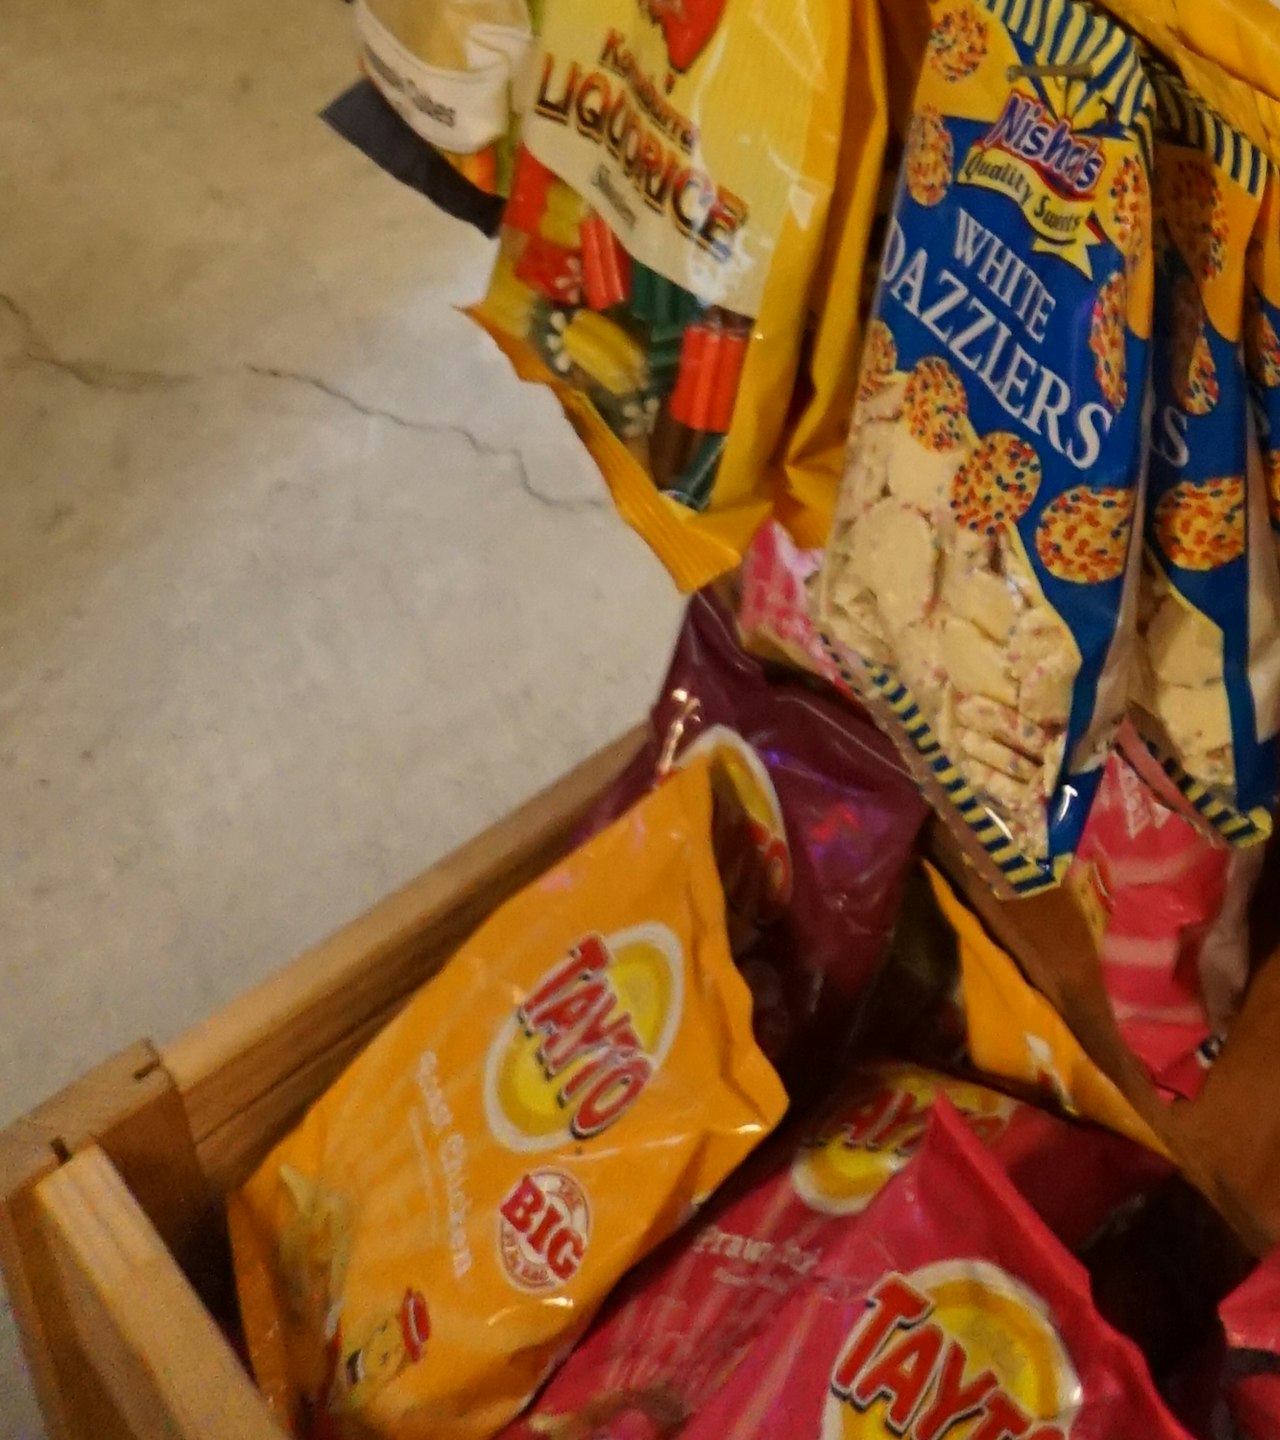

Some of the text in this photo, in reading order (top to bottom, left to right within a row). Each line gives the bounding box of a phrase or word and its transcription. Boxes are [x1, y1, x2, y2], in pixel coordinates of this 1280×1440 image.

[963, 154, 1034, 206] Quality
[988, 92, 1104, 193] Nisha's
[880, 216, 1114, 472] DAZZLERS
[954, 206, 1058, 345] WHITE
[520, 930, 654, 1139] TAYTO
[500, 1173, 585, 1283] BIG
[832, 1270, 1075, 1440] TAYT
